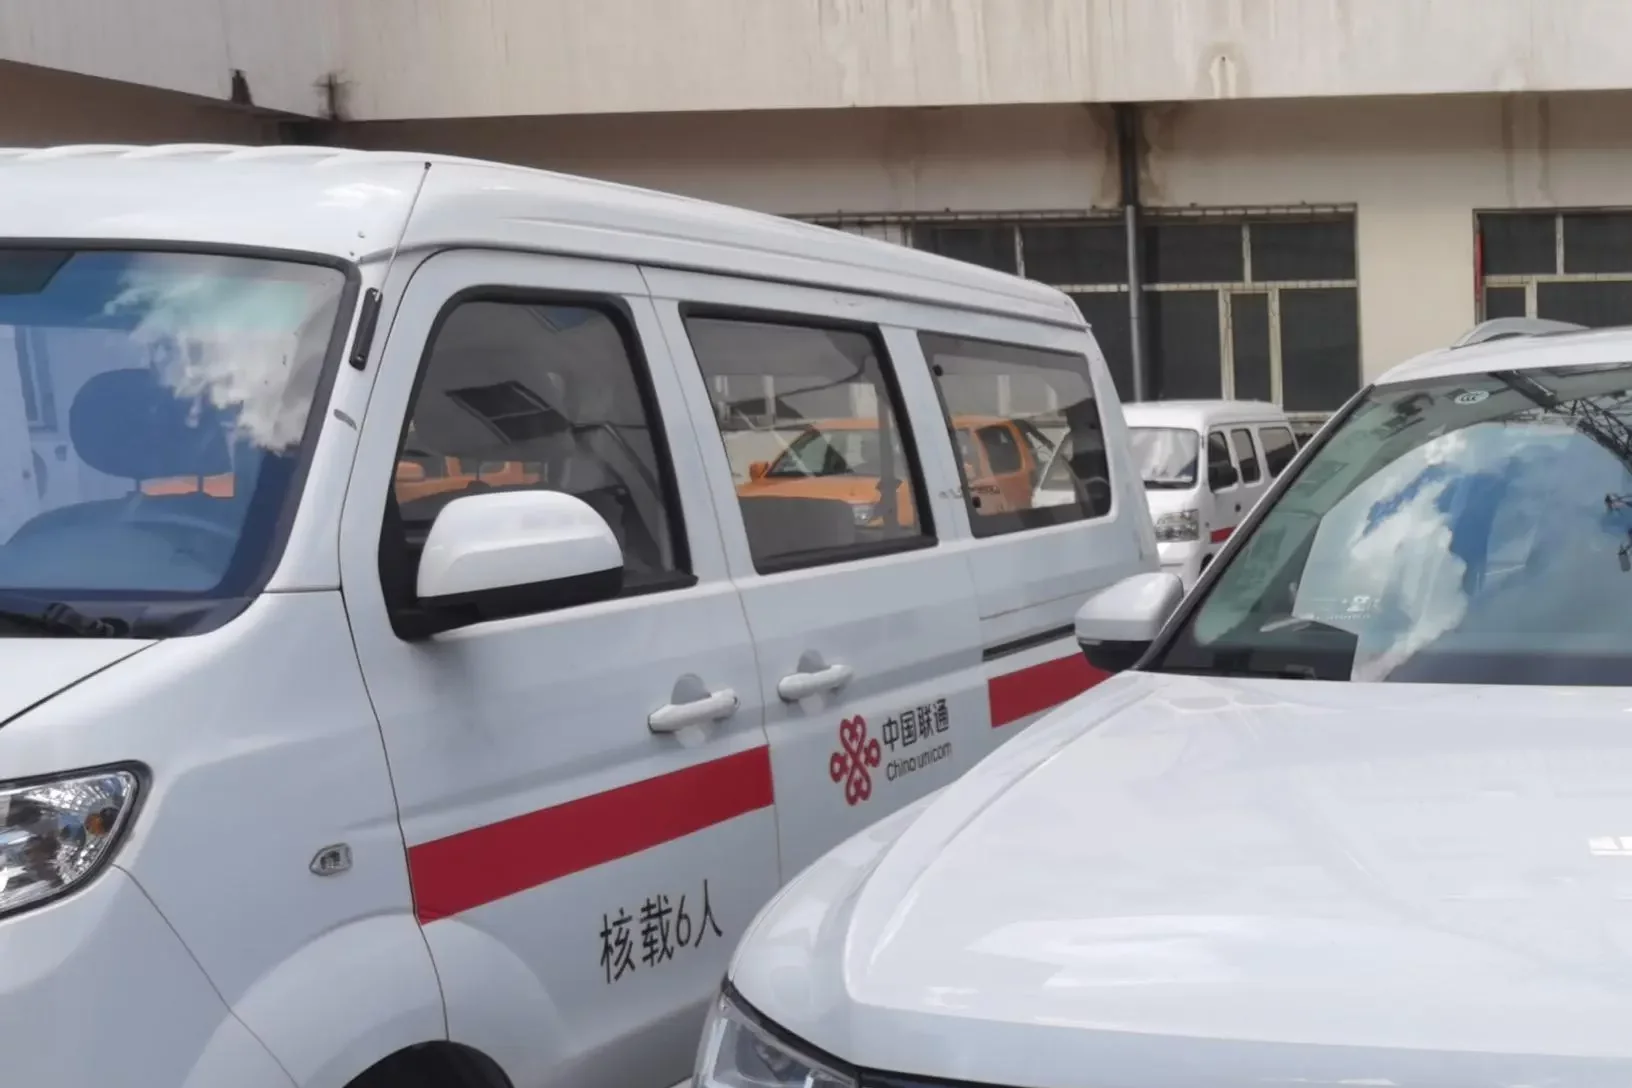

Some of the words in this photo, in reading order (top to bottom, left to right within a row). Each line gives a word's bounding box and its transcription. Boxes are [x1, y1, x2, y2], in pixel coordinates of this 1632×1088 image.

[882, 698, 949, 752] 中国联通
[600, 879, 723, 985] 核载6人
